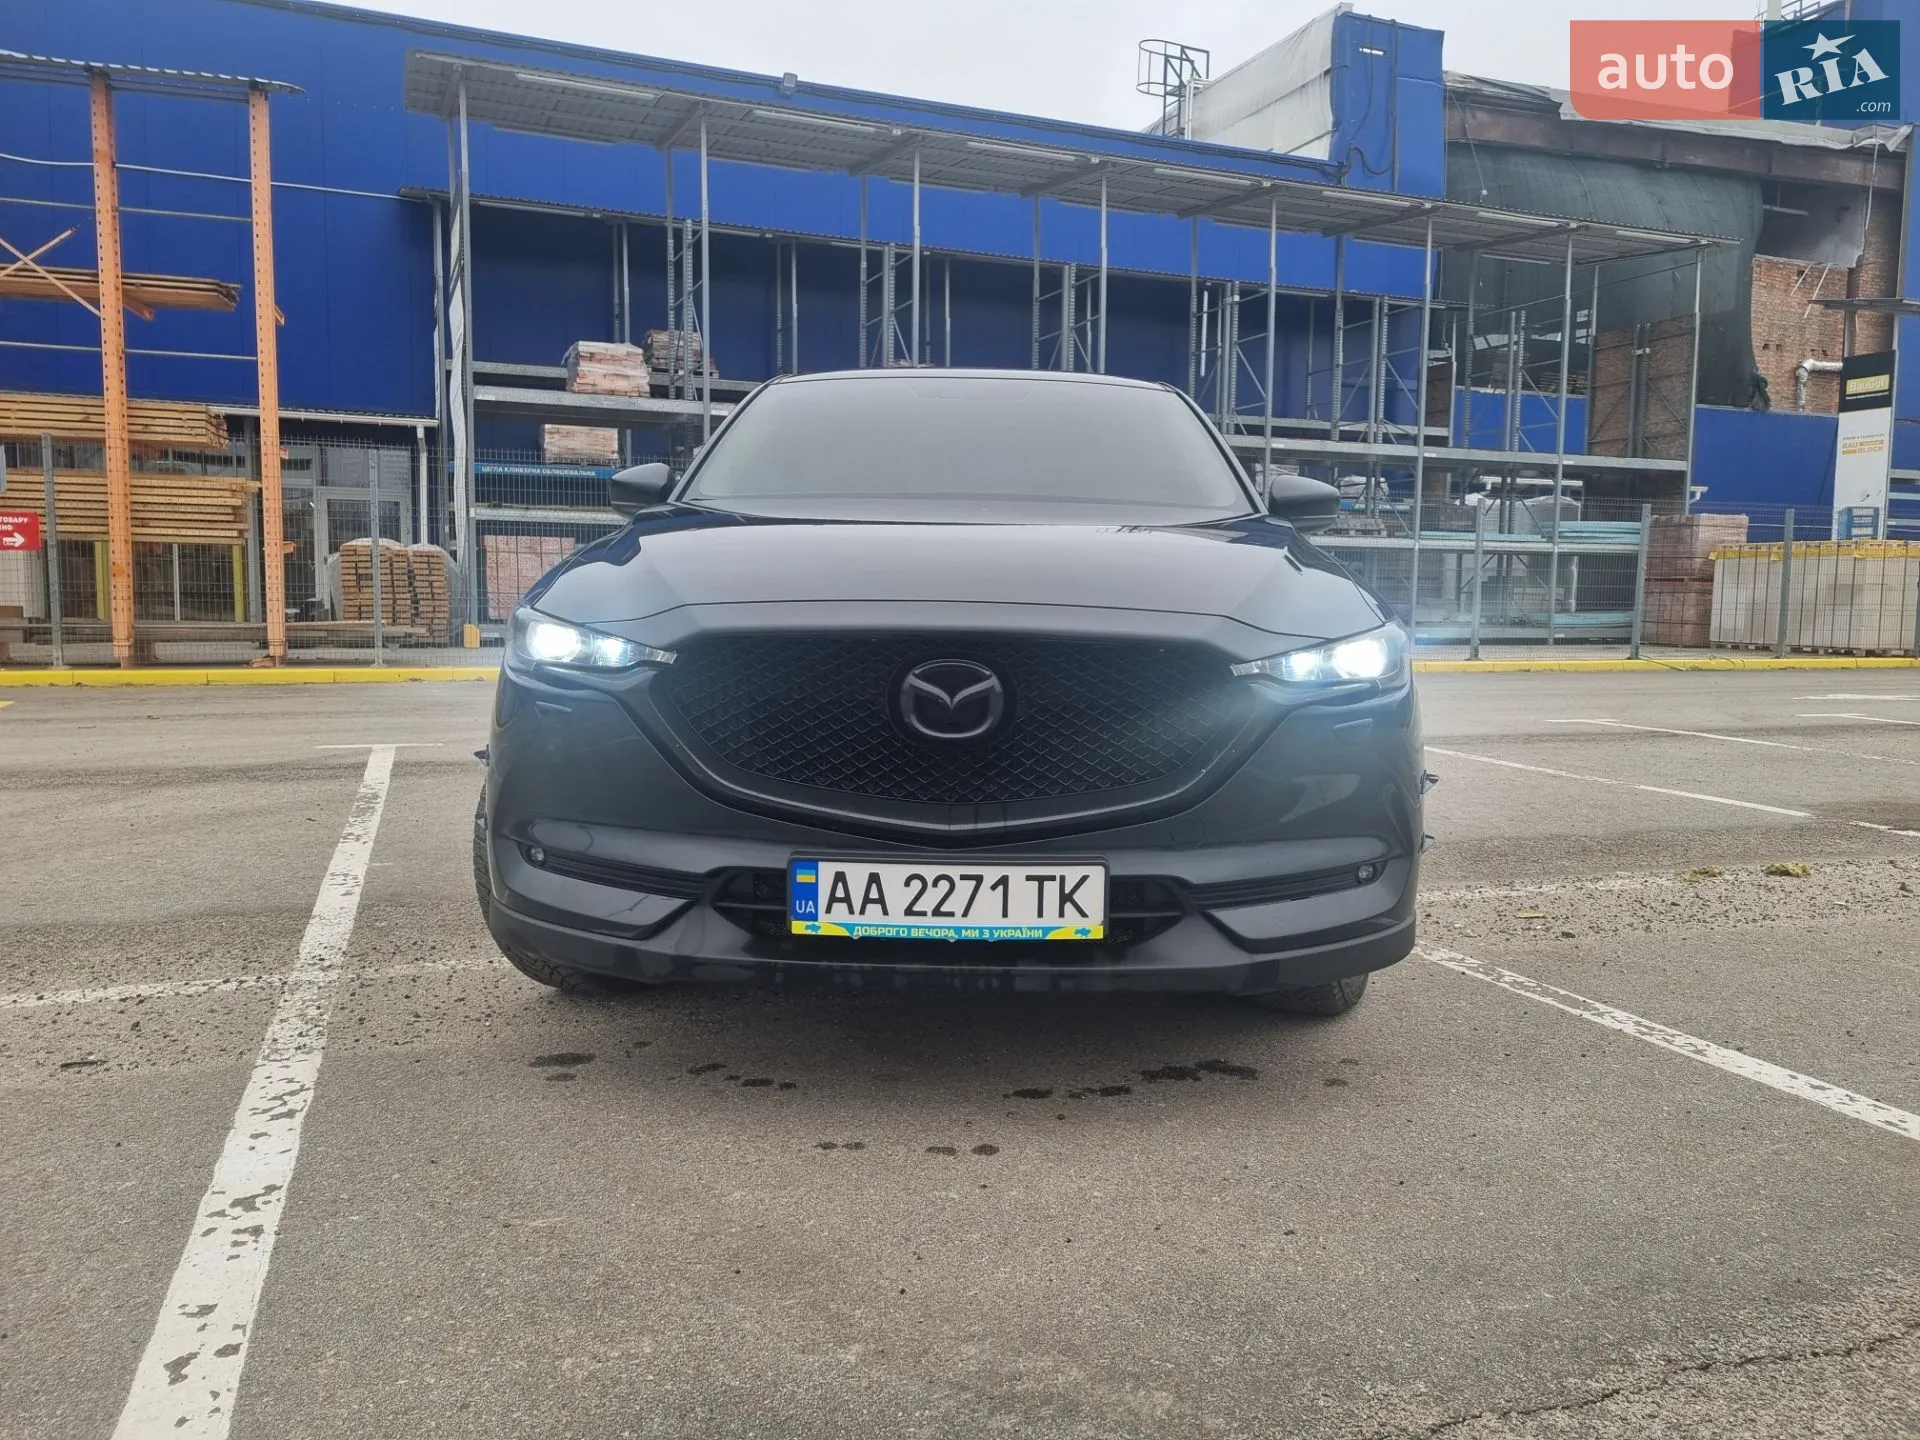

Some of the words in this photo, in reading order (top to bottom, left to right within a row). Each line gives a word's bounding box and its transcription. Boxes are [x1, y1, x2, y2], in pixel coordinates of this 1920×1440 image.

[824, 871, 889, 916] AA
[903, 873, 1009, 918] 2271
[1025, 874, 1091, 919] TK
[795, 900, 816, 914] UA
[853, 926, 907, 937] ДОБРОГО
[911, 927, 959, 938] ВЕЧОРА,
[961, 928, 979, 938] МИ
[993, 926, 1043, 938] УКРАЇНИ
